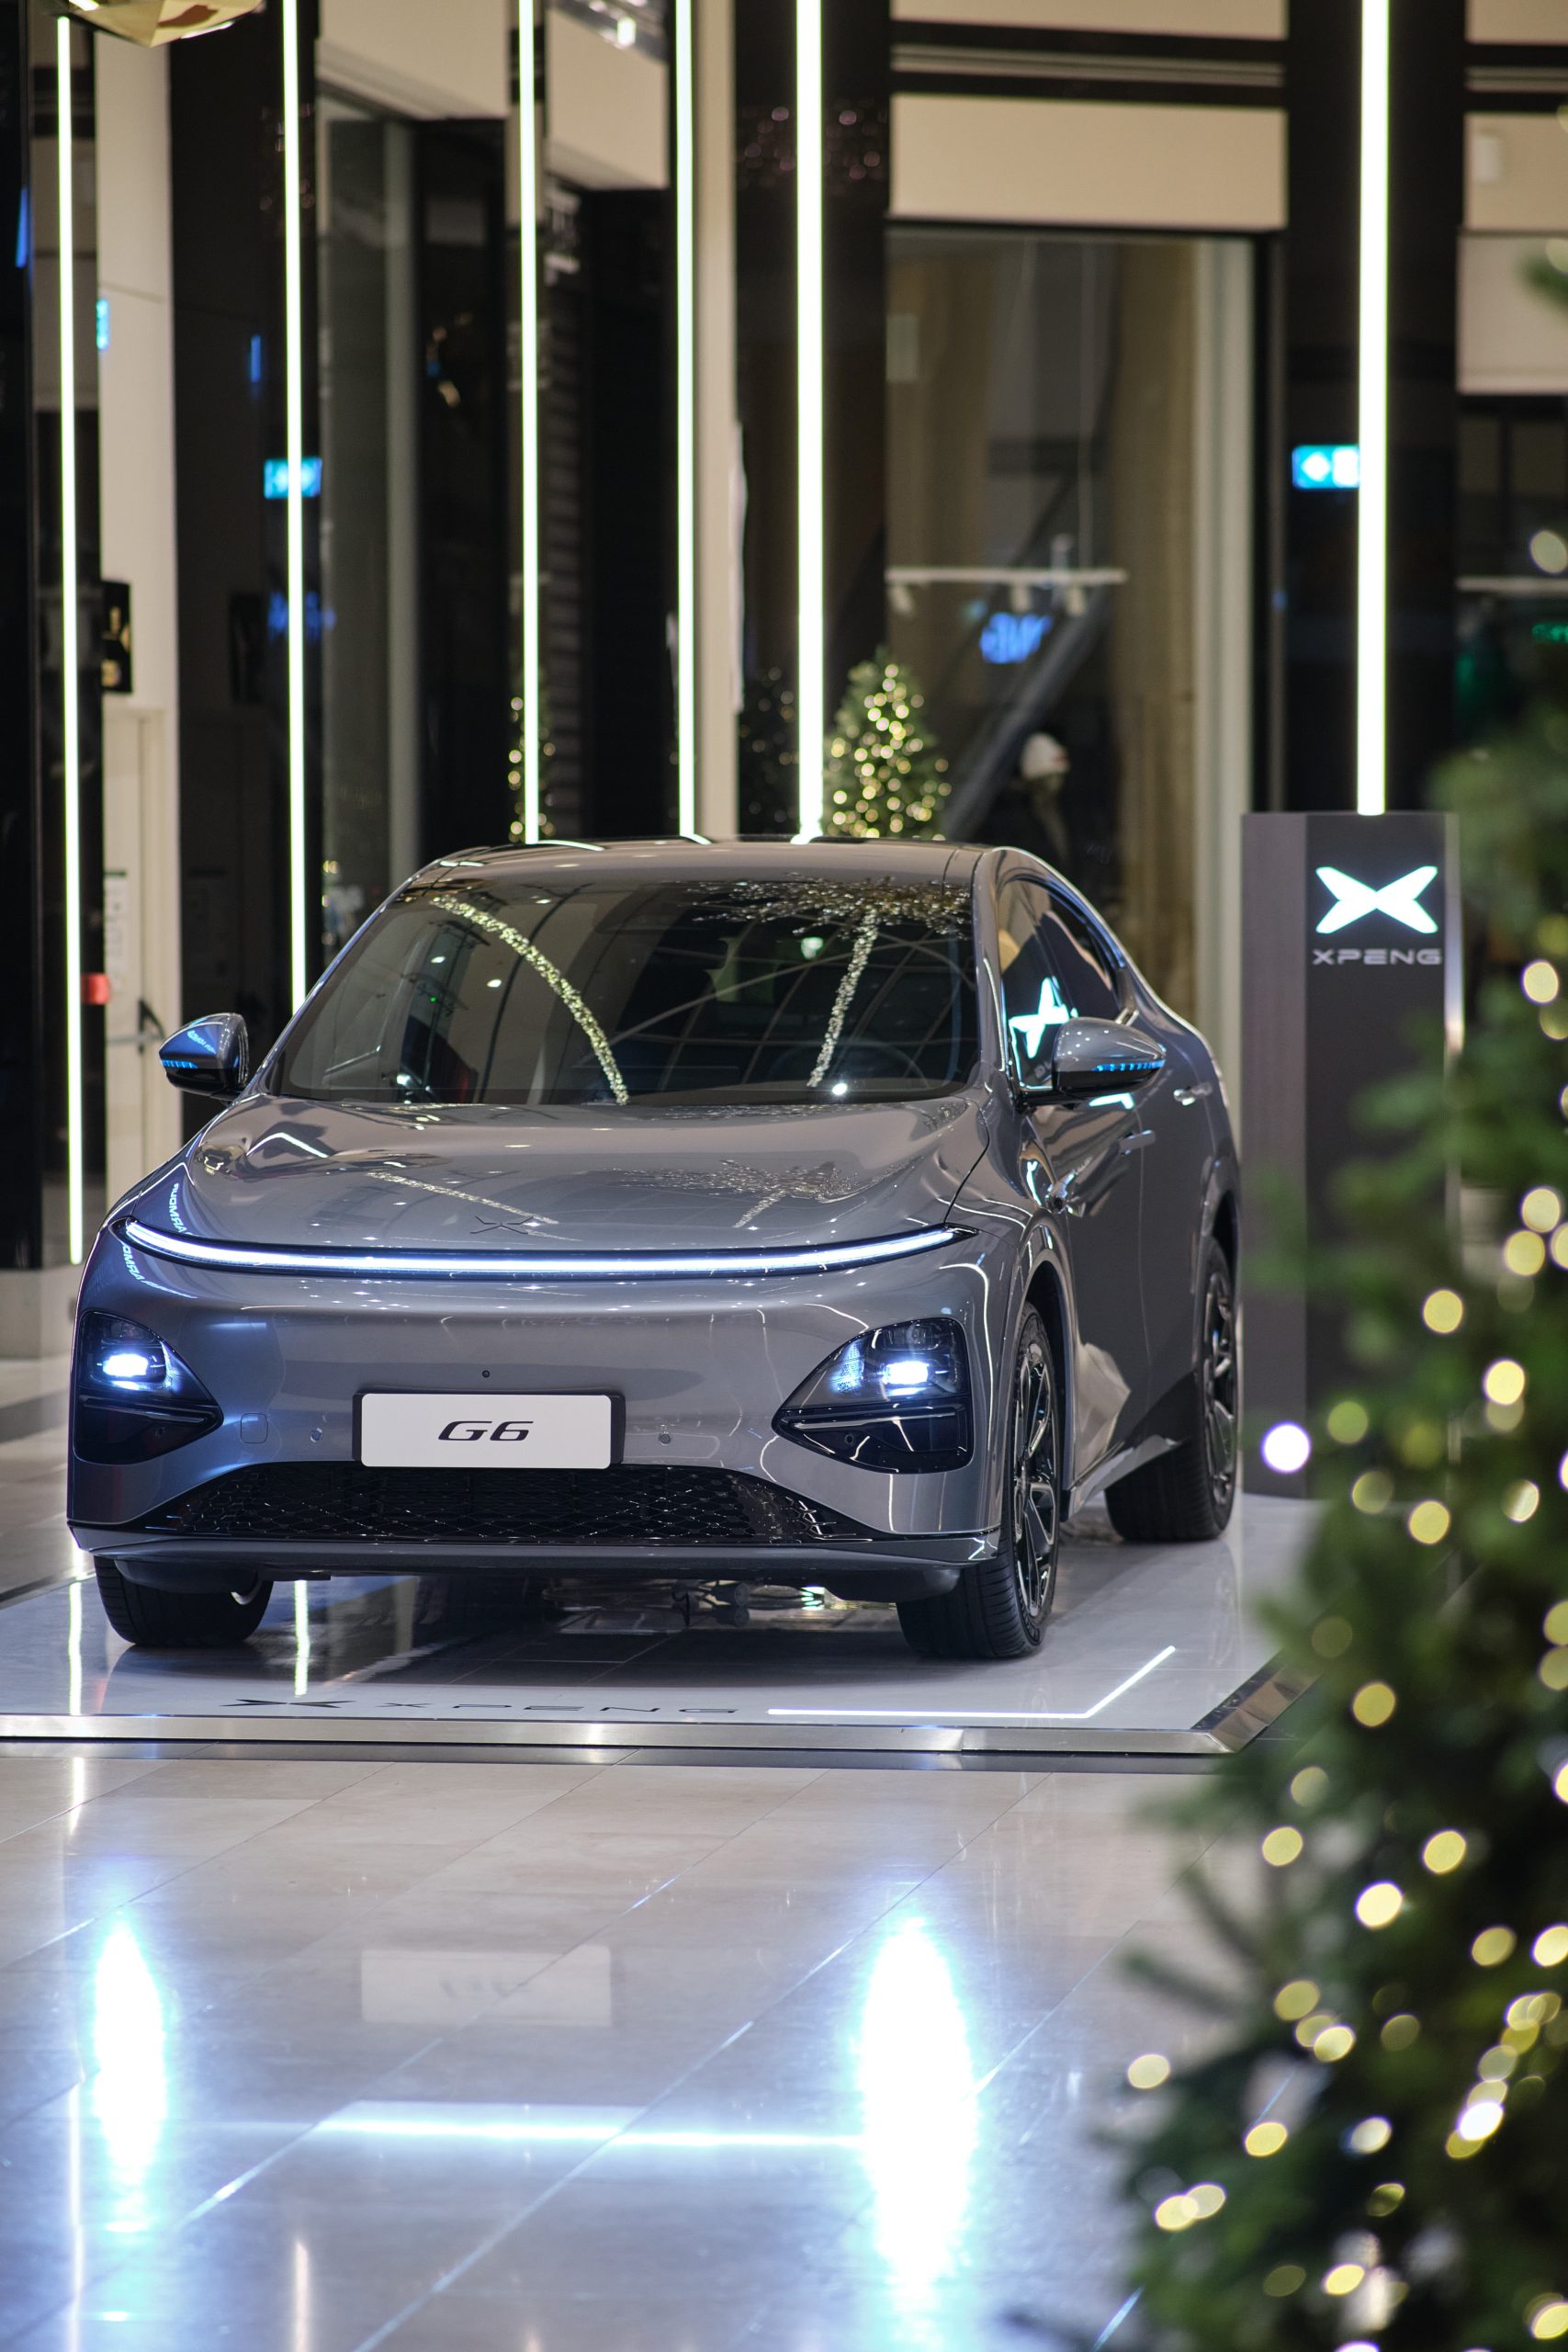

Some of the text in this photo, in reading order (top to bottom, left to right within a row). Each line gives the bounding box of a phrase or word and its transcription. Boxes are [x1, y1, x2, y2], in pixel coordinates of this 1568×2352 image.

[1313, 948, 1441, 965] XPENG
[438, 1420, 534, 1442] G6
[375, 1702, 739, 1714] XPENG
